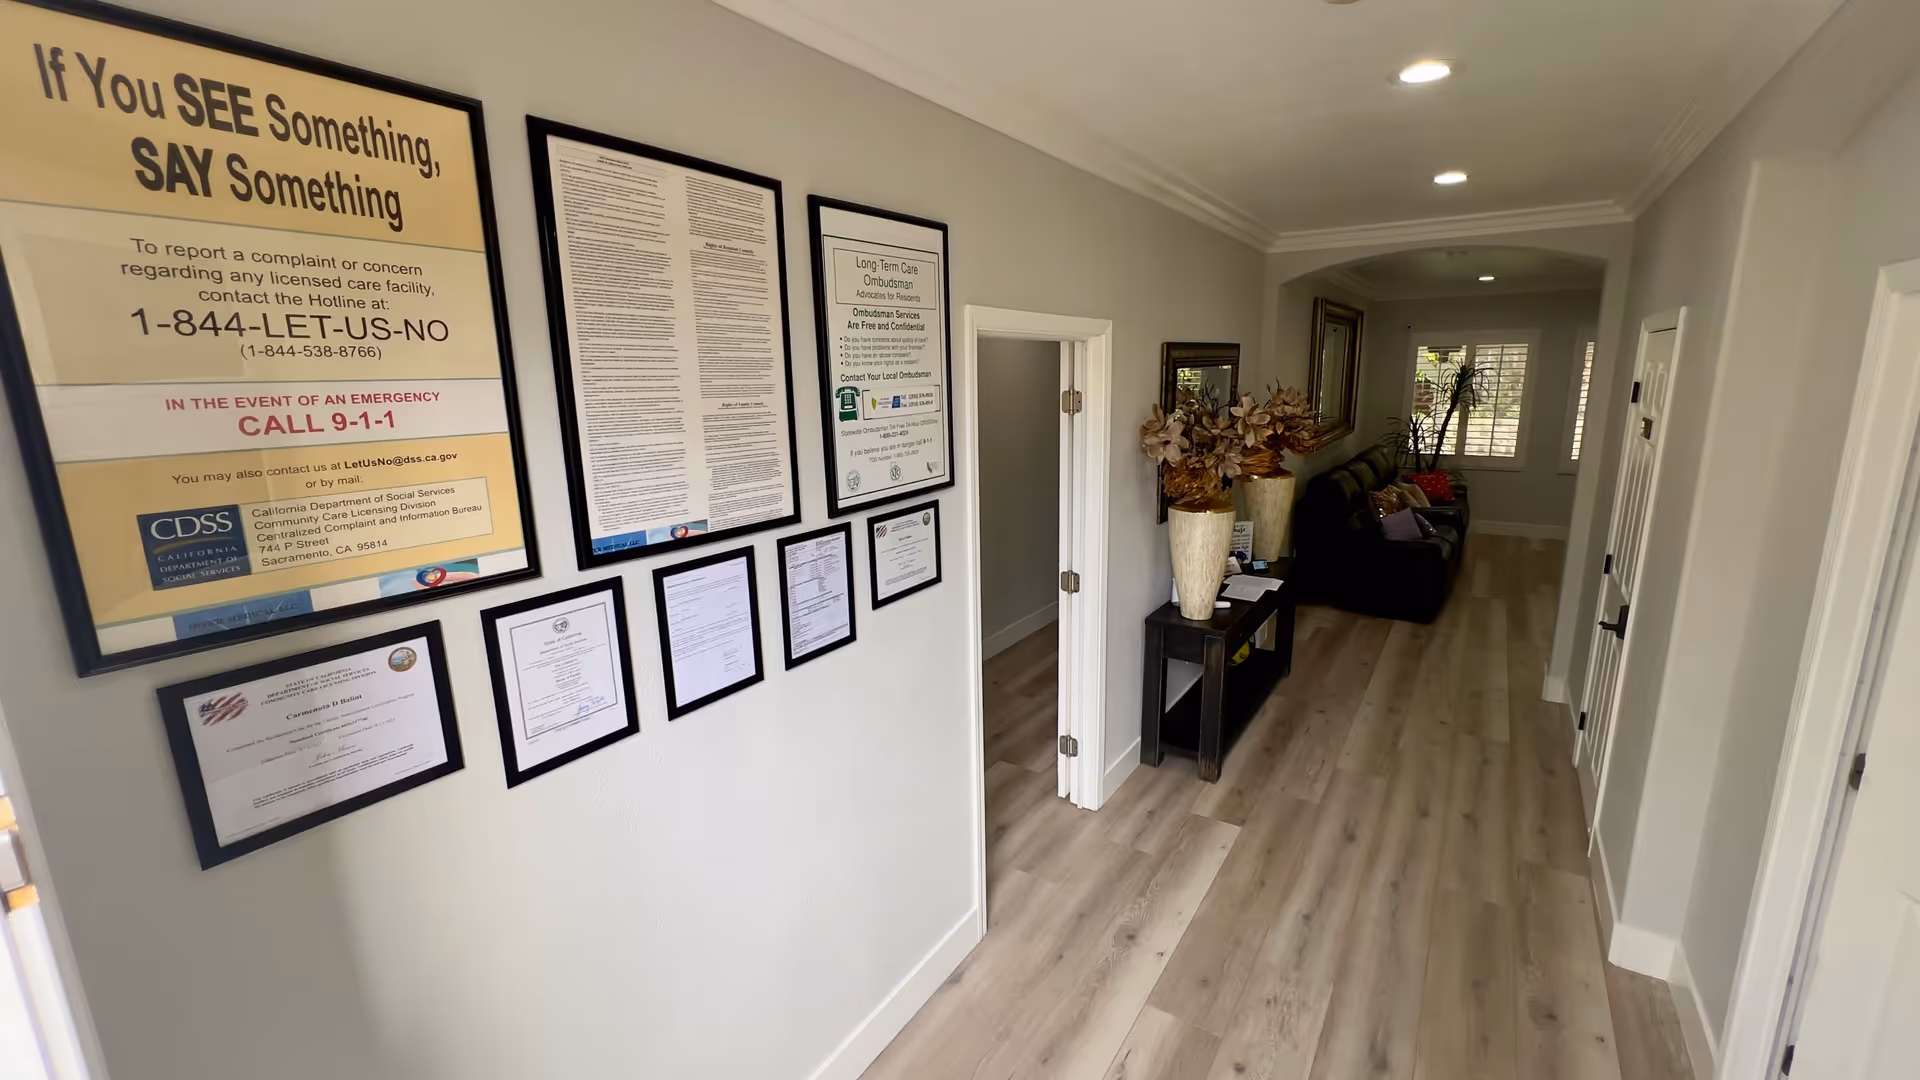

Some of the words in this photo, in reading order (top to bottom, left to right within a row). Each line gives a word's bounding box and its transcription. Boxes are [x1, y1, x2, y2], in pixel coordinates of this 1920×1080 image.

[34, 43, 68, 102] If
[75, 52, 167, 119] You
[174, 73, 259, 137] SEE
[265, 93, 440, 179] Something,
[131, 137, 213, 197] SAY
[226, 153, 403, 232] Something
[130, 238, 157, 254] To
[165, 244, 227, 260] report
[233, 250, 244, 261] a
[251, 253, 337, 269] complaint
[342, 260, 358, 270] or
[363, 262, 422, 276] concern
[856, 256, 899, 273] Long-Term
[901, 262, 918, 275] Care
[121, 264, 223, 284] regarding
[230, 271, 264, 286] any
[270, 271, 342, 288] licensed
[347, 279, 381, 291] care
[387, 280, 435, 297] facility,
[864, 274, 914, 289] Ombudsman
[199, 290, 270, 304] contact
[275, 292, 303, 305] the
[308, 294, 366, 309] Hotline
[371, 299, 390, 310] at:
[856, 289, 886, 300] Advocates
[887, 291, 895, 300] for
[896, 292, 921, 302] Residents
[852, 307, 894, 319] Ombudsman
[895, 310, 920, 320] Services
[131, 308, 449, 342] 1-844-LET-US-NO
[847, 320, 859, 330] Are
[861, 321, 876, 330] Free
[878, 322, 889, 330] and
[890, 322, 925, 331] Confidential
[240, 344, 382, 361] (1-844-538-8766)
[840, 373, 865, 382] Contact
[867, 372, 881, 380] Your
[882, 371, 898, 380] Local
[899, 371, 931, 379] Ombudsman
[165, 399, 185, 411] IN
[191, 398, 229, 410] THE
[235, 396, 292, 408] EVENT
[297, 395, 320, 406] OF
[325, 394, 346, 405] AN
[351, 392, 440, 404] EMERGENCY
[238, 414, 325, 436] CALL
[331, 410, 396, 431] 9-1-1
[172, 474, 199, 485] You
[203, 473, 232, 483] may
[236, 468, 263, 479] also
[266, 464, 311, 477] contact
[314, 463, 327, 473] us
[330, 461, 342, 471] at
[344, 452, 458, 470] LetUsNo@dss.ca.gov
[305, 480, 318, 489] or
[321, 478, 334, 489] by
[337, 475, 363, 486] mail:
[252, 504, 307, 518] California
[310, 496, 371, 511] Department
[374, 494, 383, 503] of
[386, 491, 415, 502] Social
[418, 487, 455, 498] Services
[254, 515, 319, 530] Community
[322, 511, 348, 521] Care
[351, 504, 397, 518] Licensing
[400, 500, 436, 511] Division
[256, 526, 321, 542] Centralized
[324, 518, 377, 533] Complaint
[379, 516, 397, 526] and
[400, 508, 450, 522] Information
[453, 504, 482, 515] Bureau
[150, 511, 233, 540] CDSS
[157, 546, 239, 562] CALIFORNIA
[259, 544, 280, 554] 744
[284, 541, 293, 551] P
[296, 537, 330, 549] Street
[335, 545, 352, 555] CA
[357, 539, 388, 551] 95814
[160, 558, 223, 573] DEPARTMENT
[162, 572, 197, 583] SOCIAL
[200, 565, 241, 577] SERVICES
